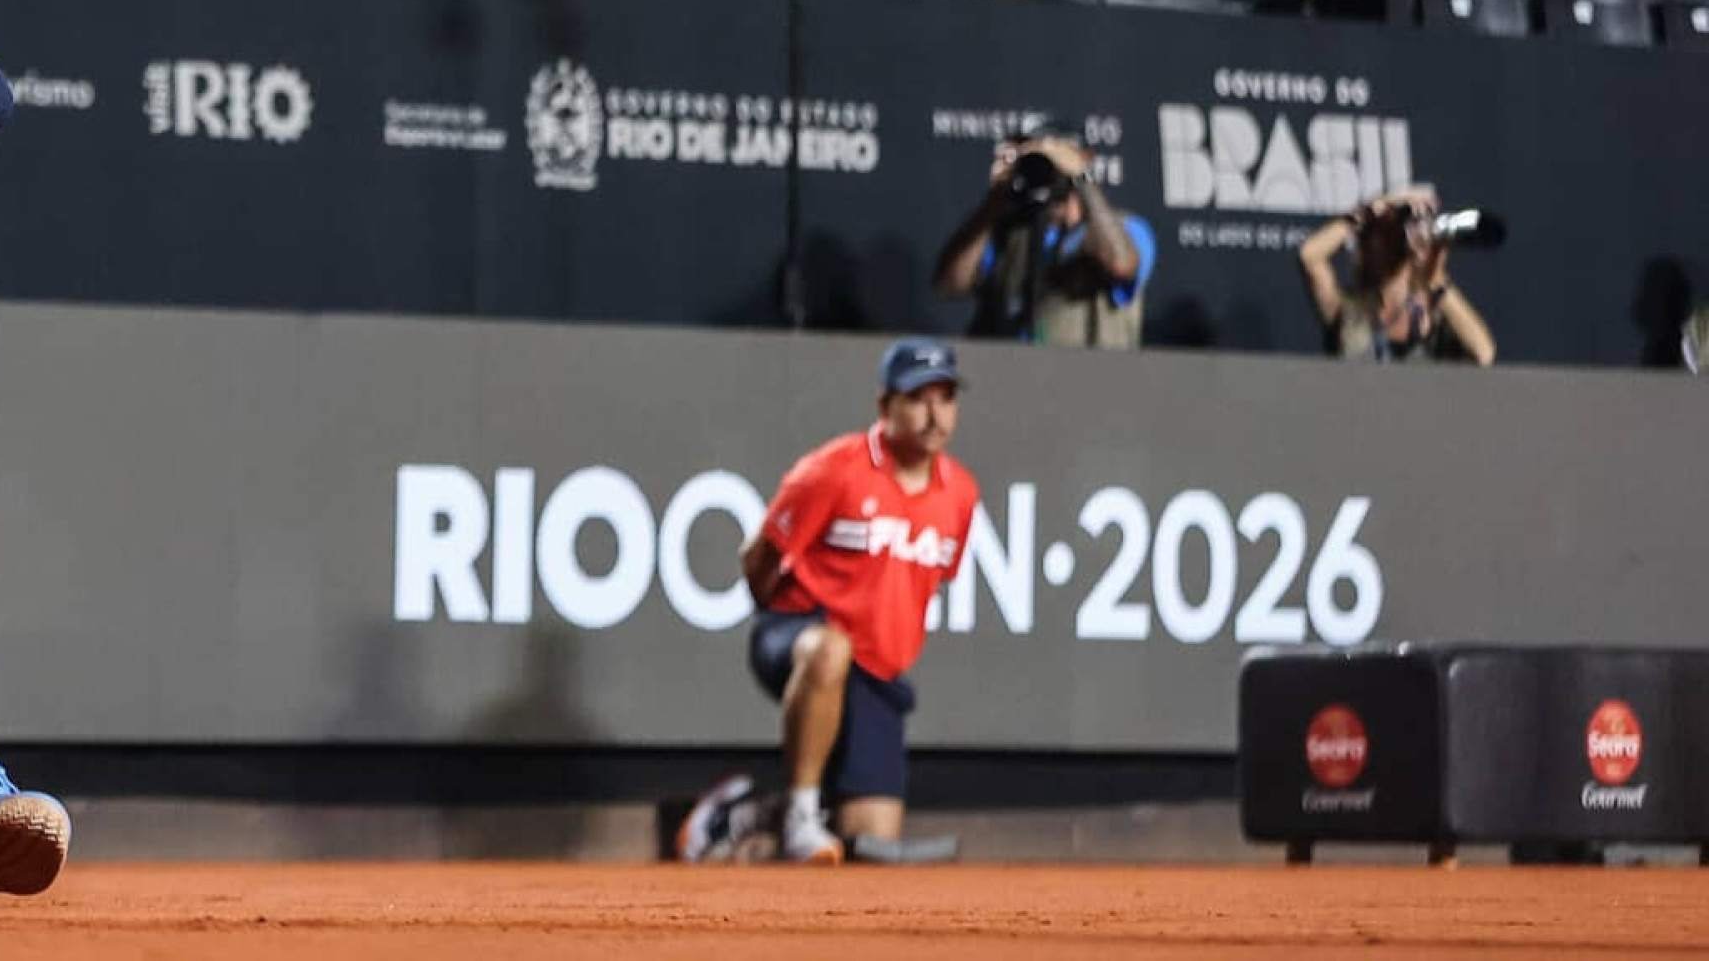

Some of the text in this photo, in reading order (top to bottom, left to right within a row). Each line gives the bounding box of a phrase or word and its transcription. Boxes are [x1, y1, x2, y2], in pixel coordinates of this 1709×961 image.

[174, 59, 313, 144] RIO
[1214, 67, 1370, 106] GOVERNO DO
[606, 87, 730, 121] GOVERNO
[736, 93, 773, 126] DO
[607, 117, 674, 160] RIO
[677, 121, 727, 164] DE
[1085, 114, 1123, 146] DO
